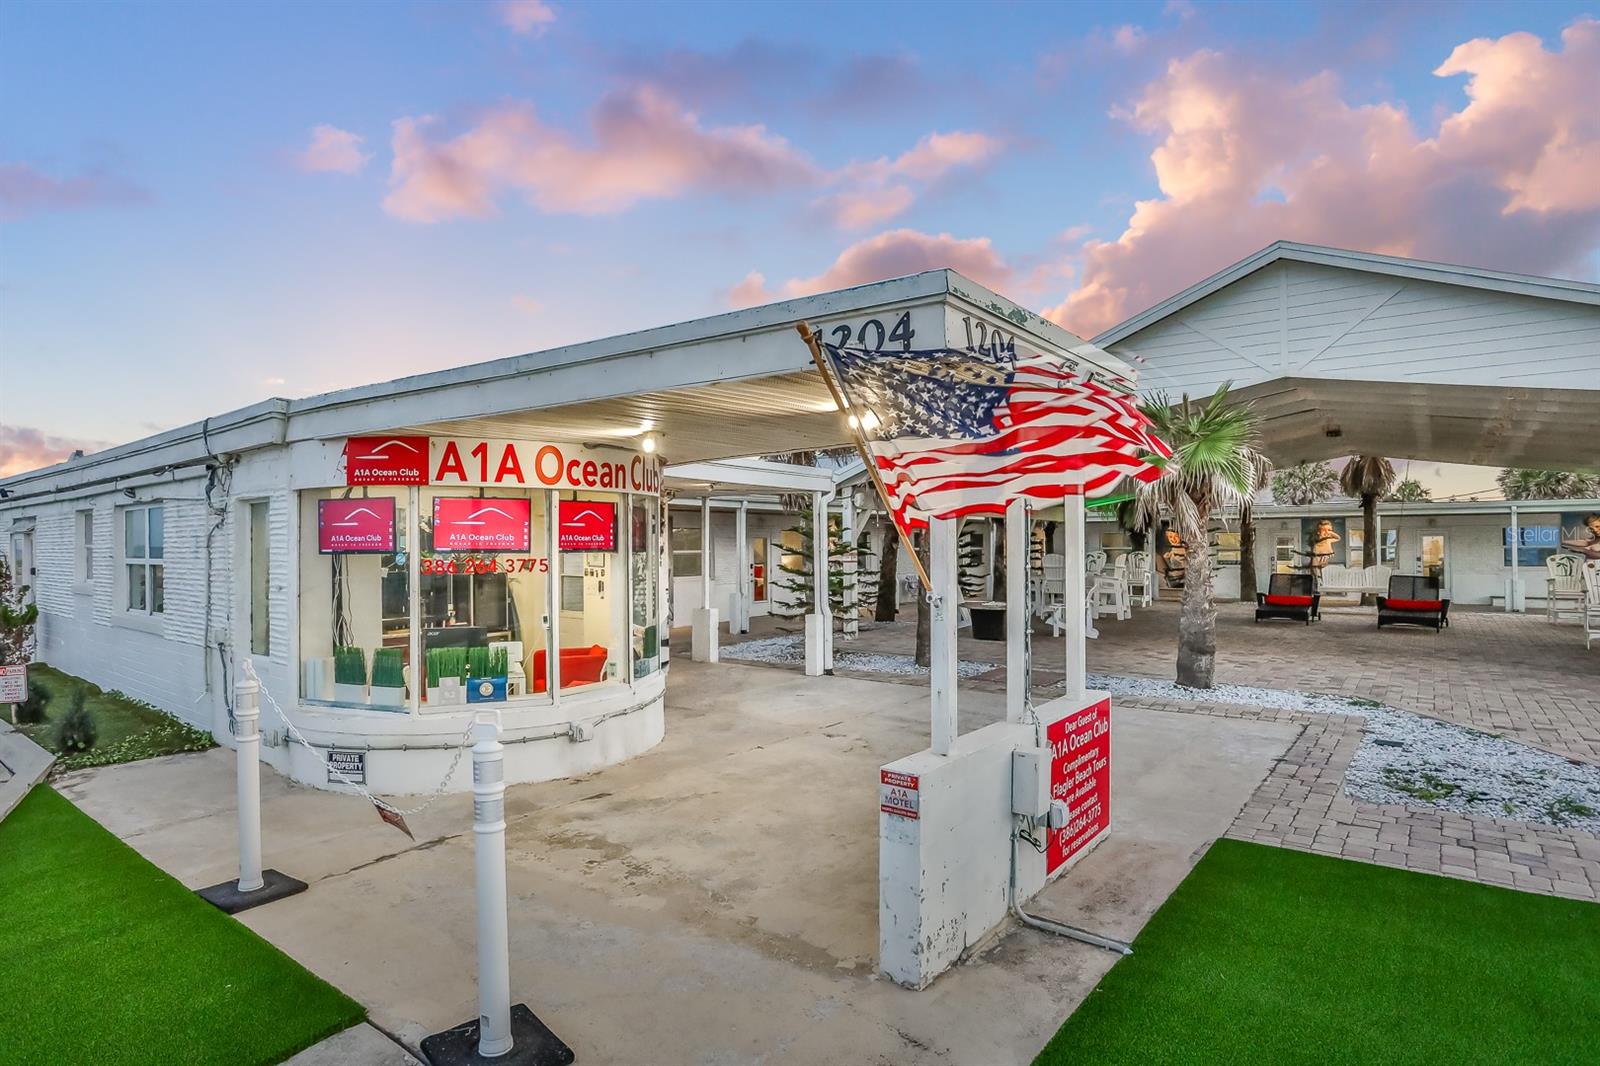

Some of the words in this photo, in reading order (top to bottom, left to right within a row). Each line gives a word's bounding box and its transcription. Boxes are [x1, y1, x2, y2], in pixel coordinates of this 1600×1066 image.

[962, 316, 1019, 370] 1204
[354, 468, 370, 476] A1A
[372, 468, 398, 476] Ocean
[400, 468, 420, 476] Club
[435, 441, 525, 484] A1A
[534, 444, 627, 489] Ocean
[630, 454, 659, 495] Club
[345, 534, 366, 542] Ocean
[366, 534, 382, 542] Club
[449, 533, 467, 541] A1A
[468, 533, 494, 541] Ocean
[496, 533, 515, 541] Club
[505, 558, 549, 573] 3775
[1065, 721, 1078, 734] Dear
[1077, 712, 1092, 728] Guest
[1092, 707, 1098, 720] of
[1051, 738, 1068, 760] A1A
[1069, 729, 1092, 751] Ocean
[1094, 717, 1109, 738] Club
[329, 762, 363, 770] PROPERTY
[332, 754, 359, 763] PRIVATE
[1063, 747, 1099, 774] Complimentary
[884, 777, 914, 788] PROPERTY
[887, 773, 911, 782] PRIVATE
[1053, 777, 1075, 798] Flagler
[1075, 763, 1093, 784] Beach
[1093, 757, 1107, 773] Tours
[890, 787, 908, 798] A1A
[1074, 776, 1097, 799] Available
[885, 795, 914, 809] MOTEL
[1081, 792, 1098, 812] contact
[1062, 844, 1071, 858] for
[1071, 822, 1099, 850] reservations
